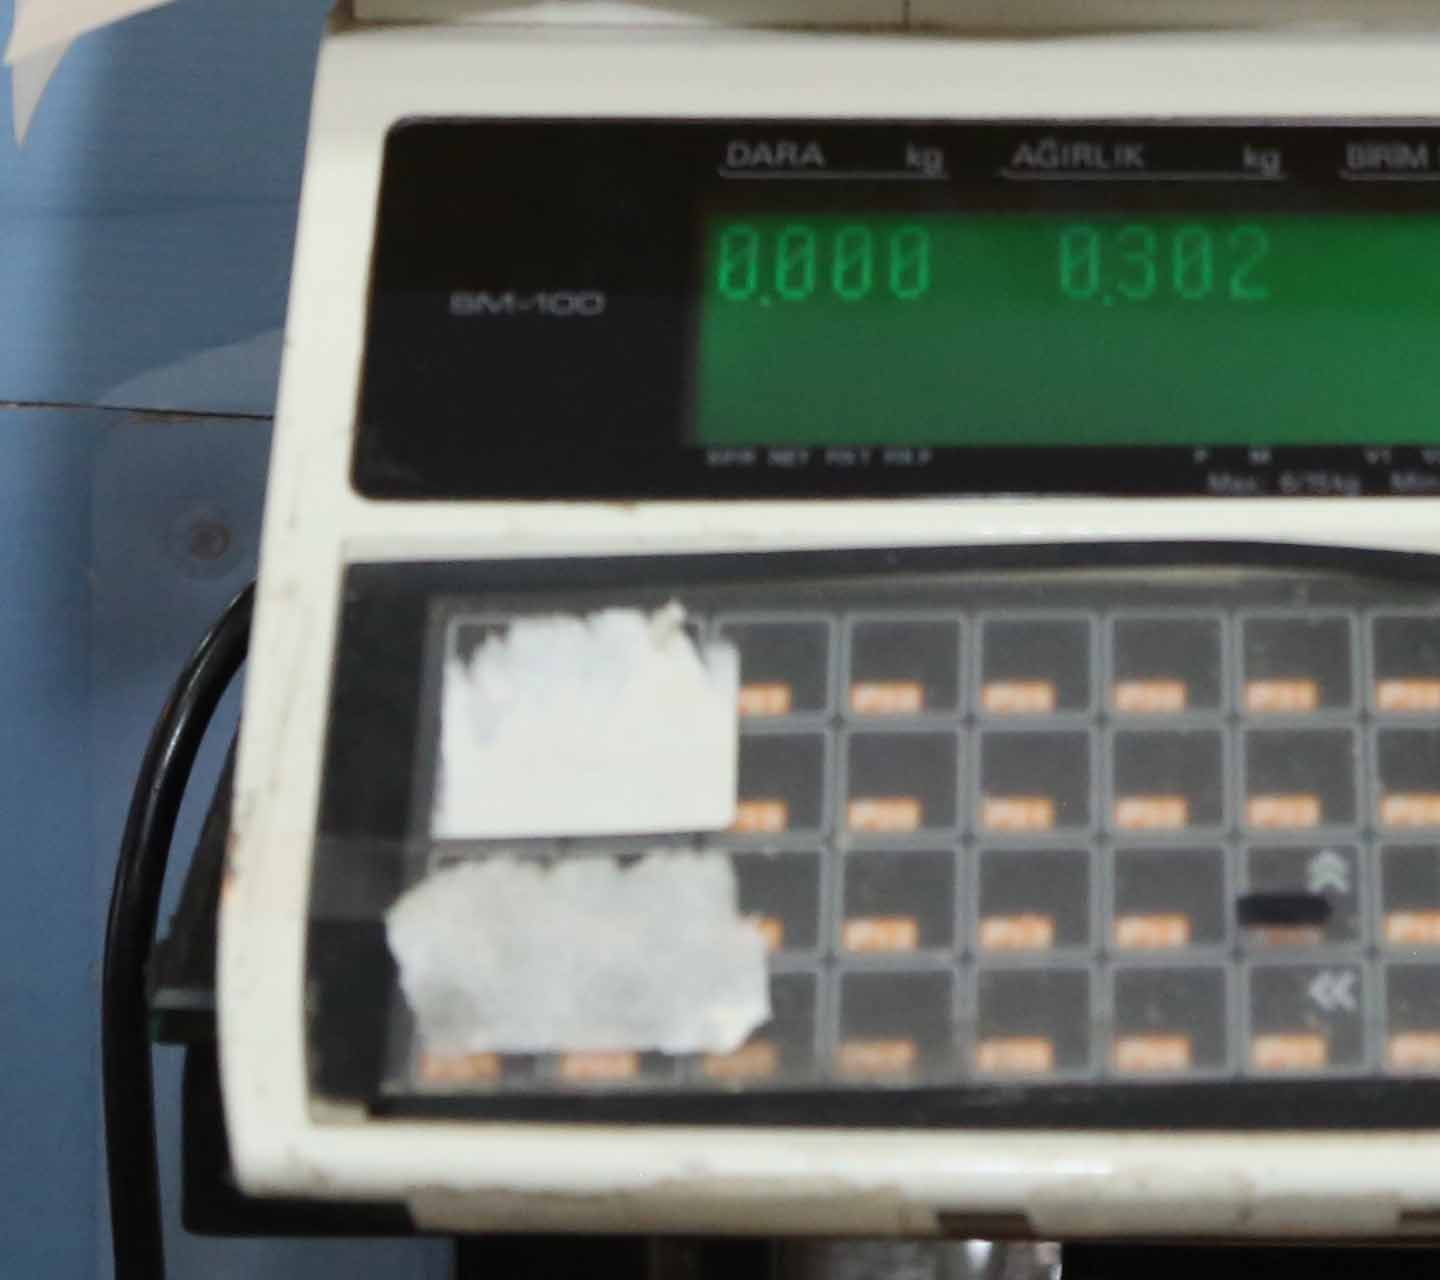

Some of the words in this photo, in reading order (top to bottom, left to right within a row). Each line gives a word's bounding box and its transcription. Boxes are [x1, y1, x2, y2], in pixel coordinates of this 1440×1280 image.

[724, 142, 826, 169] DARA
[906, 143, 945, 175] kg
[1011, 137, 1146, 169] AĞIRLIK
[1241, 145, 1282, 176] kg
[1059, 224, 1272, 307] 0.302
